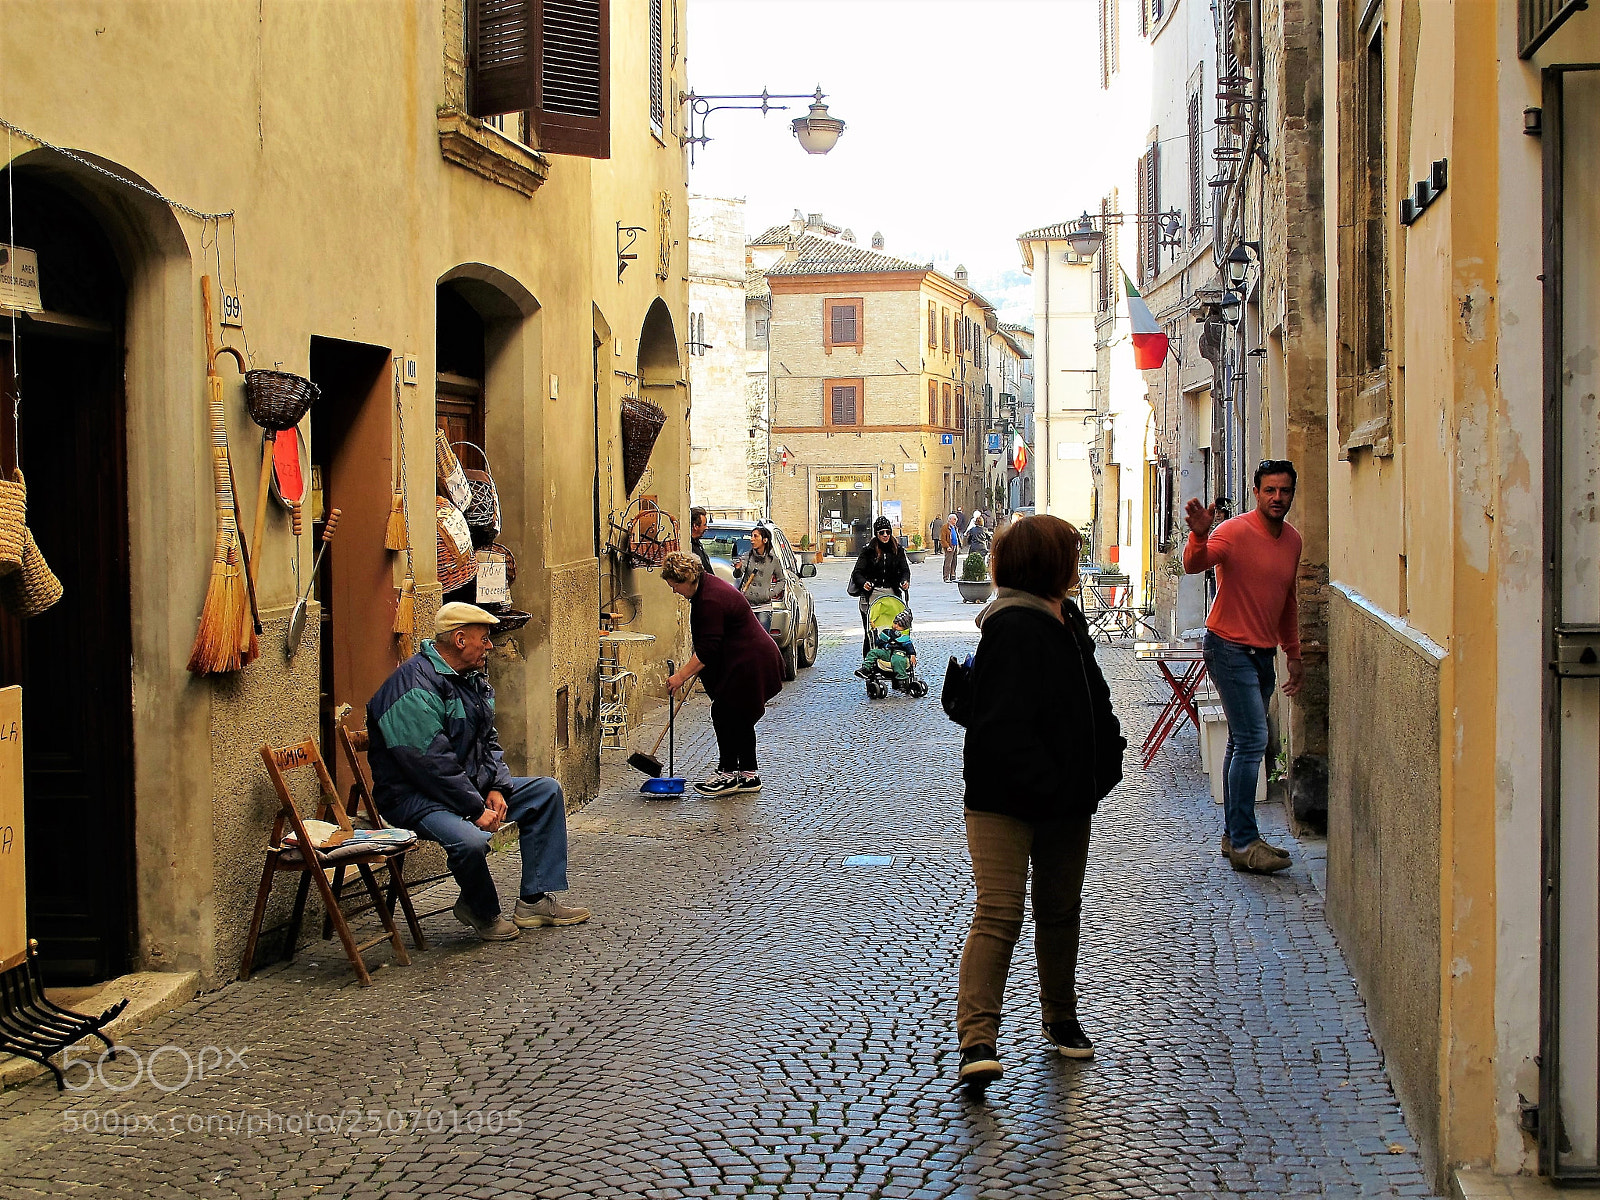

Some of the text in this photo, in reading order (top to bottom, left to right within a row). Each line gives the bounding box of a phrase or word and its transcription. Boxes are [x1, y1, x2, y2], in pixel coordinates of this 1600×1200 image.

[22, 264, 36, 275] AREA
[225, 295, 240, 318] 99
[407, 360, 416, 377] 101
